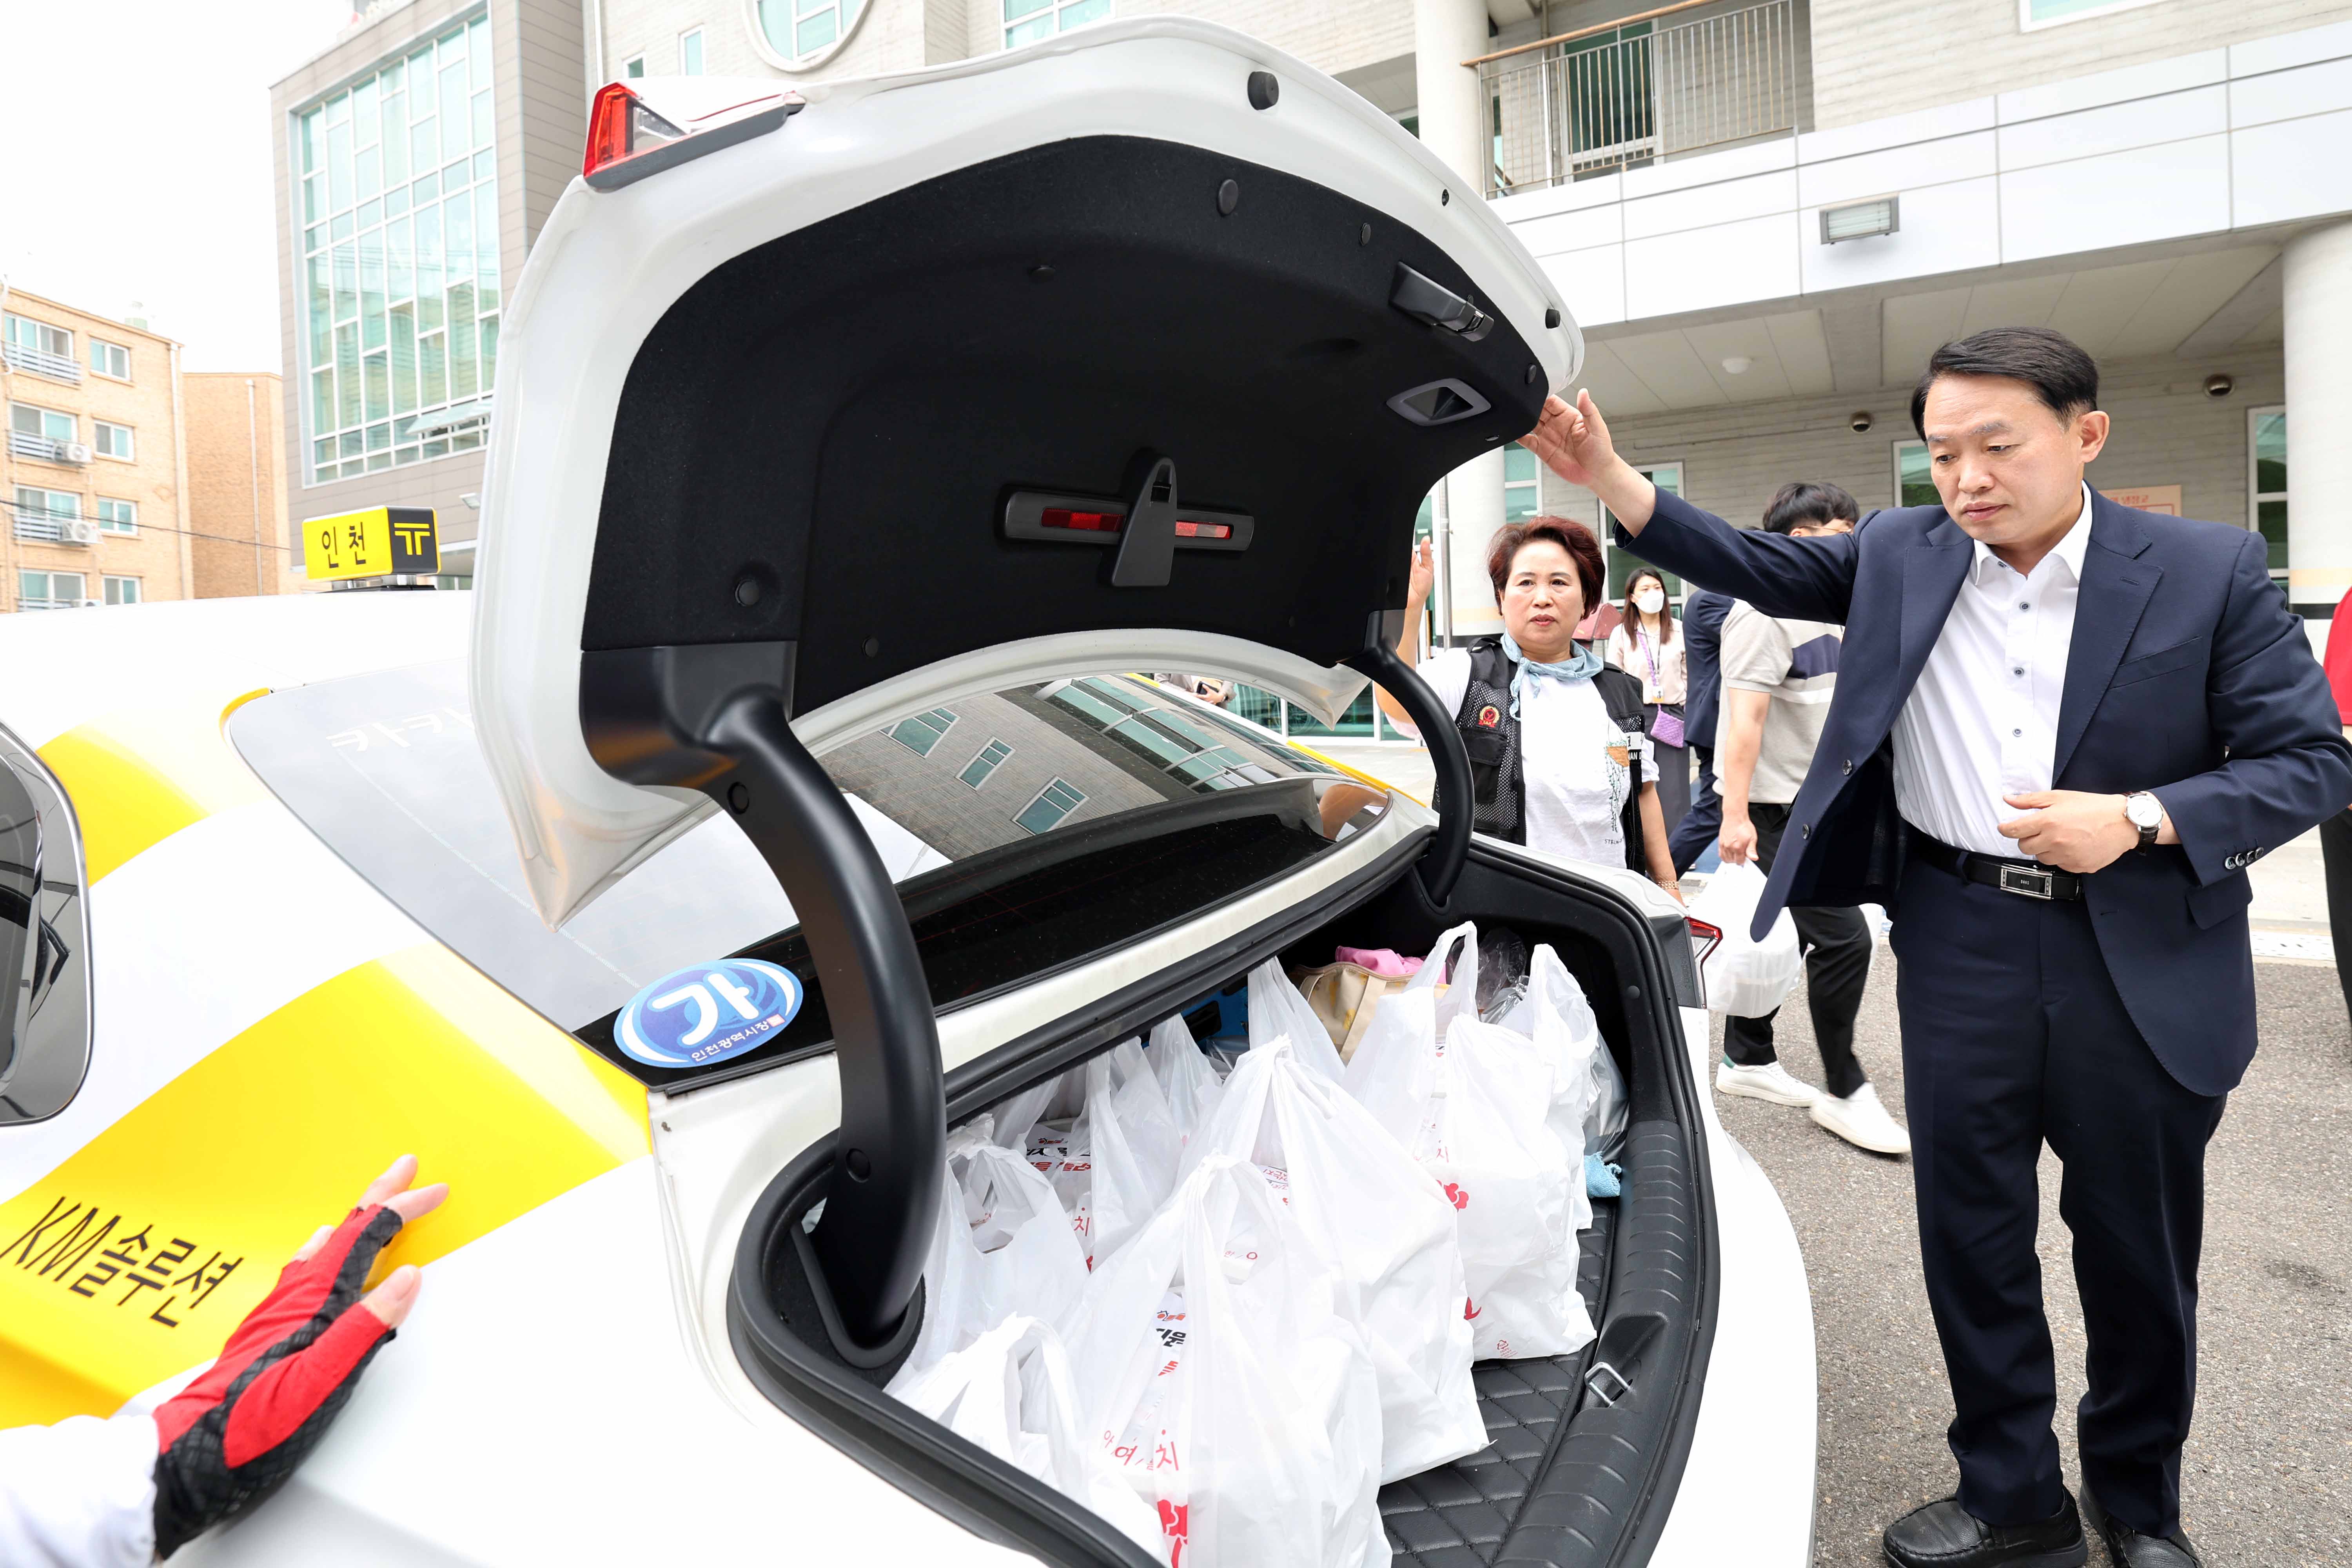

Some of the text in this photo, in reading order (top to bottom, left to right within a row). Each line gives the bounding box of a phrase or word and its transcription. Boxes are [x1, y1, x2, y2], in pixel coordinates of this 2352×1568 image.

[321, 522, 366, 568] 인천
[652, 973, 759, 1045] 가
[691, 1021, 769, 1062] 인천광역시장
[0, 1196, 244, 1328] KM솔루션
